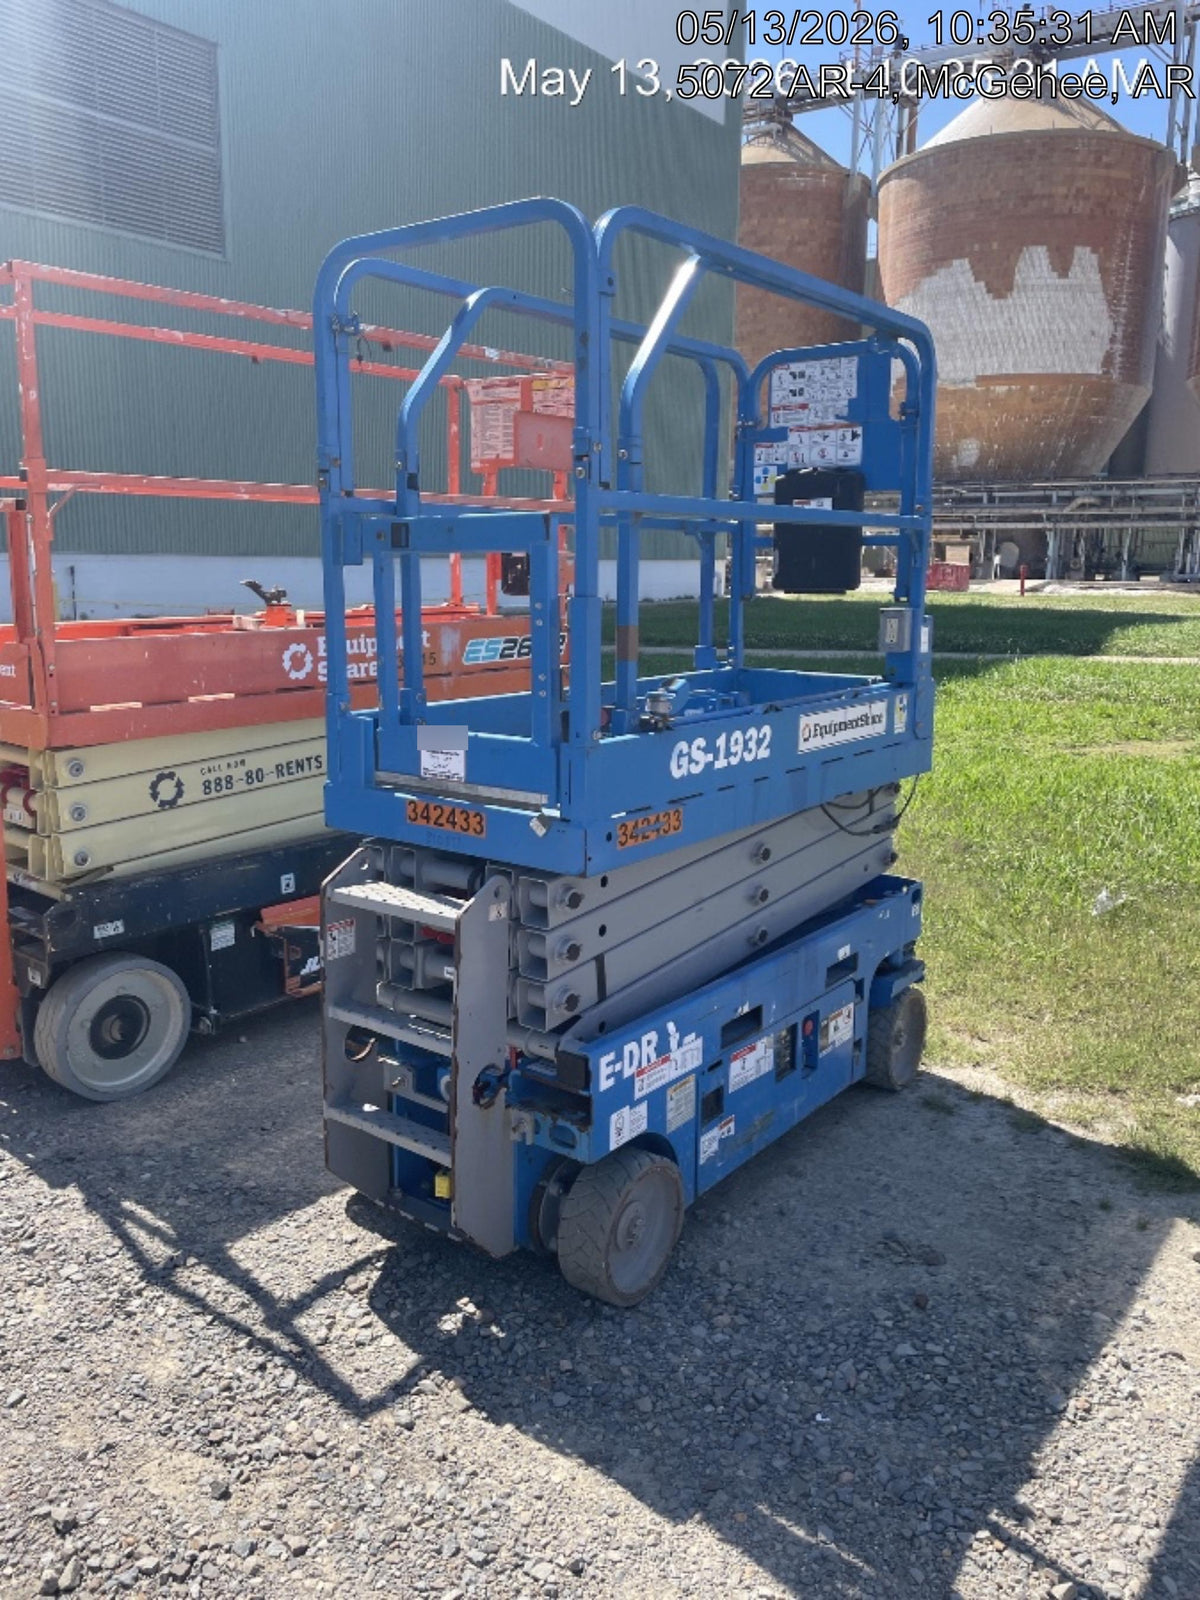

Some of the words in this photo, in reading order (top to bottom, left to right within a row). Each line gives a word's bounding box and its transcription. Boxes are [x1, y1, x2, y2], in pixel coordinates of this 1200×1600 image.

[317, 661, 378, 682] Sare
[669, 724, 773, 779] GS-1932
[202, 755, 323, 796] 888-80-RENTS
[407, 800, 485, 836] 342433
